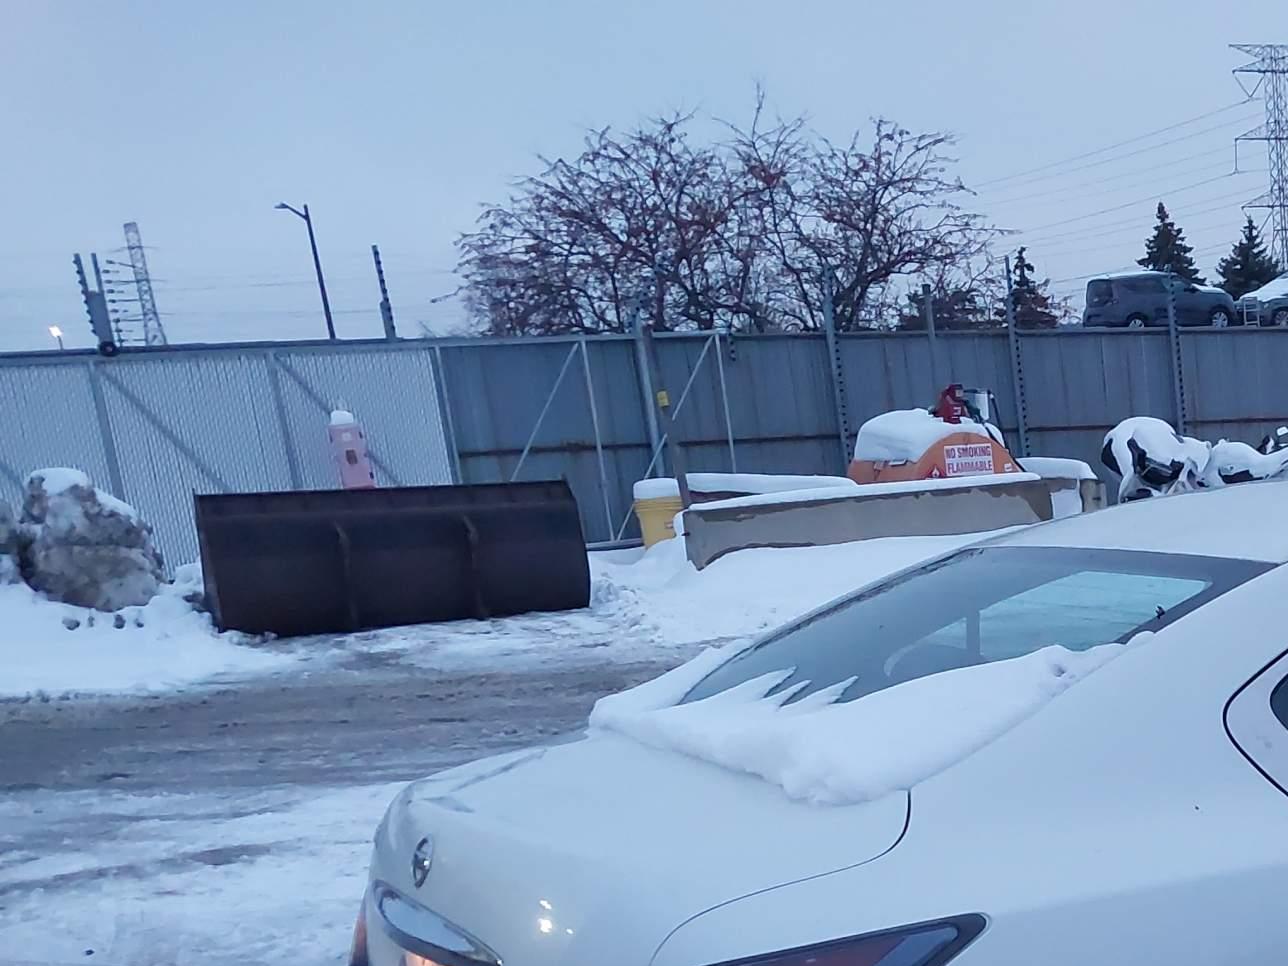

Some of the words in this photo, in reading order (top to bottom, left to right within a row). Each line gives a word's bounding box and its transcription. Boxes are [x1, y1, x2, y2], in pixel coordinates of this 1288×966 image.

[945, 447, 956, 459] NO
[957, 446, 991, 458] SMOKING
[947, 461, 992, 473] FLAMMABLE
